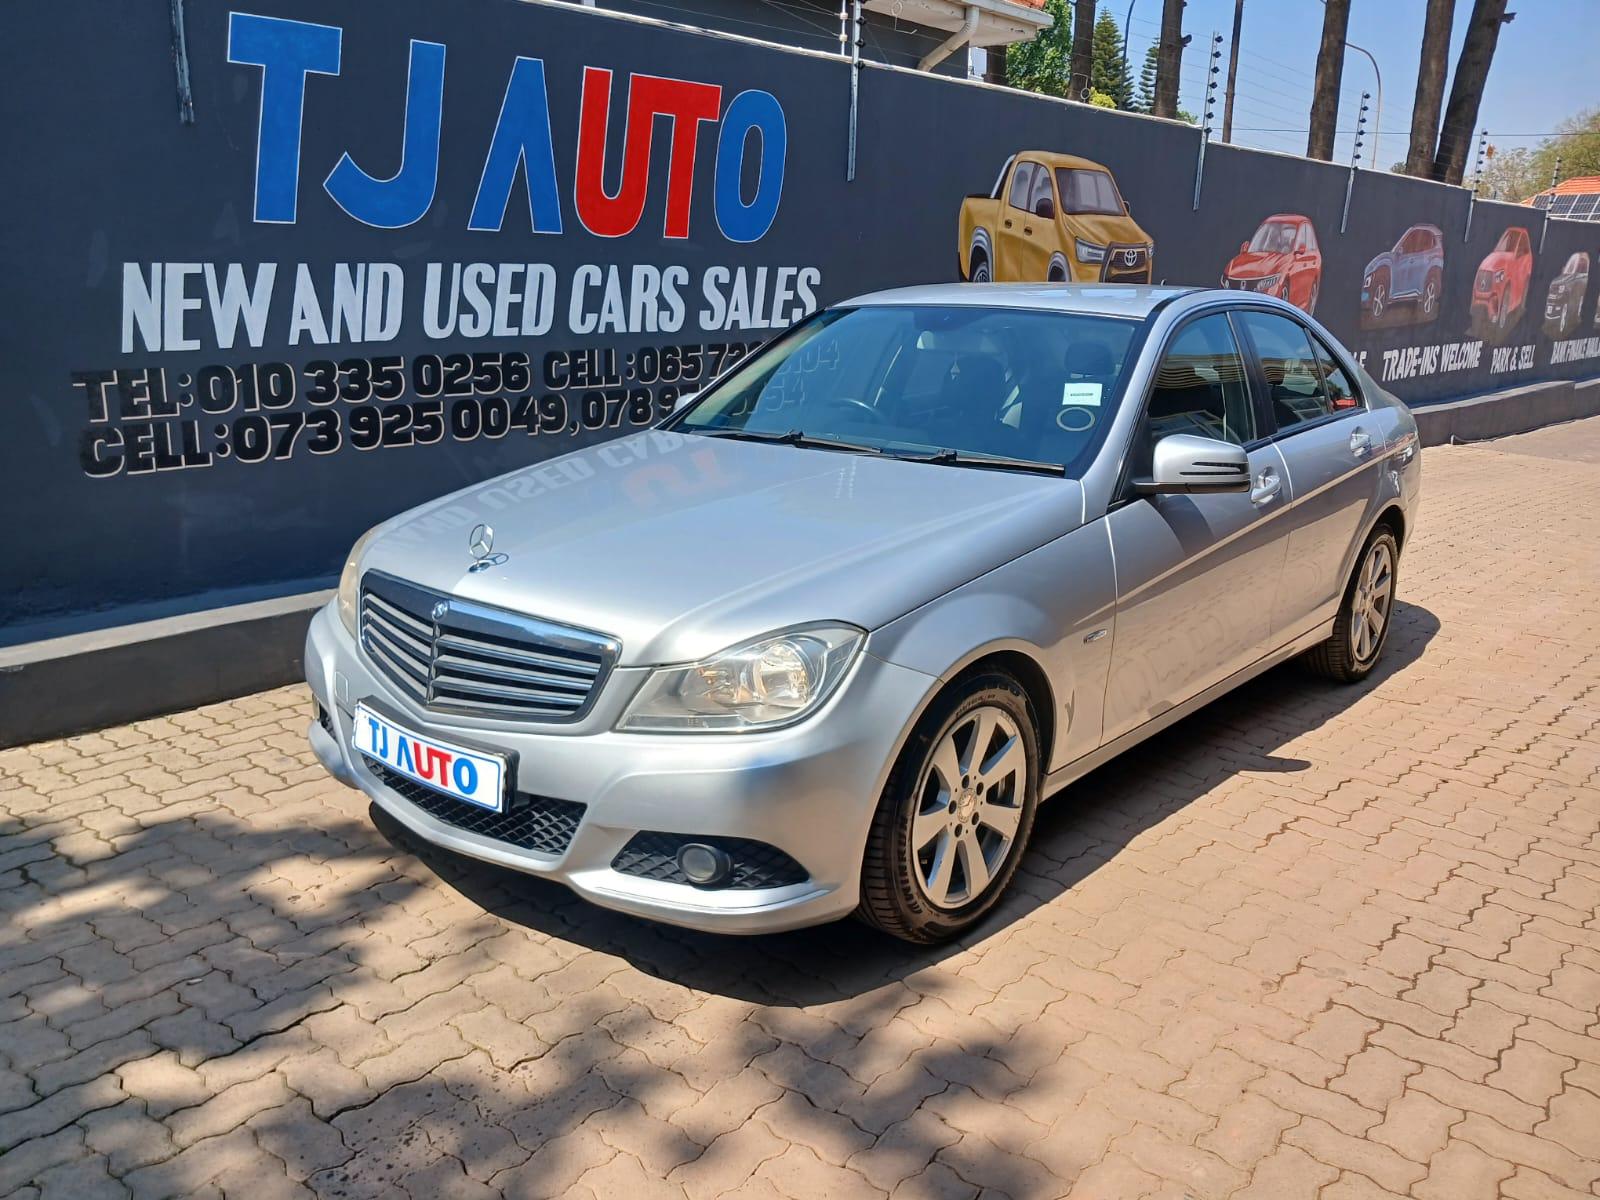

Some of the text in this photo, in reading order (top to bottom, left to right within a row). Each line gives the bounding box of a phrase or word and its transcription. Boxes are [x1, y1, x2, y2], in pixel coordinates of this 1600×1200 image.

[227, 11, 787, 243] TJ AUTO
[121, 262, 821, 354] NEW AND USED CARS SALES
[304, 355, 405, 406] 335
[412, 352, 530, 398] 0256
[1382, 345, 1440, 382] TRADE-INS
[1440, 340, 1483, 373] WELCOME
[1490, 347, 1510, 375] PARK
[1518, 345, 1536, 369] SELL
[349, 400, 445, 450] 925
[368, 717, 478, 796] TJ AUTO
